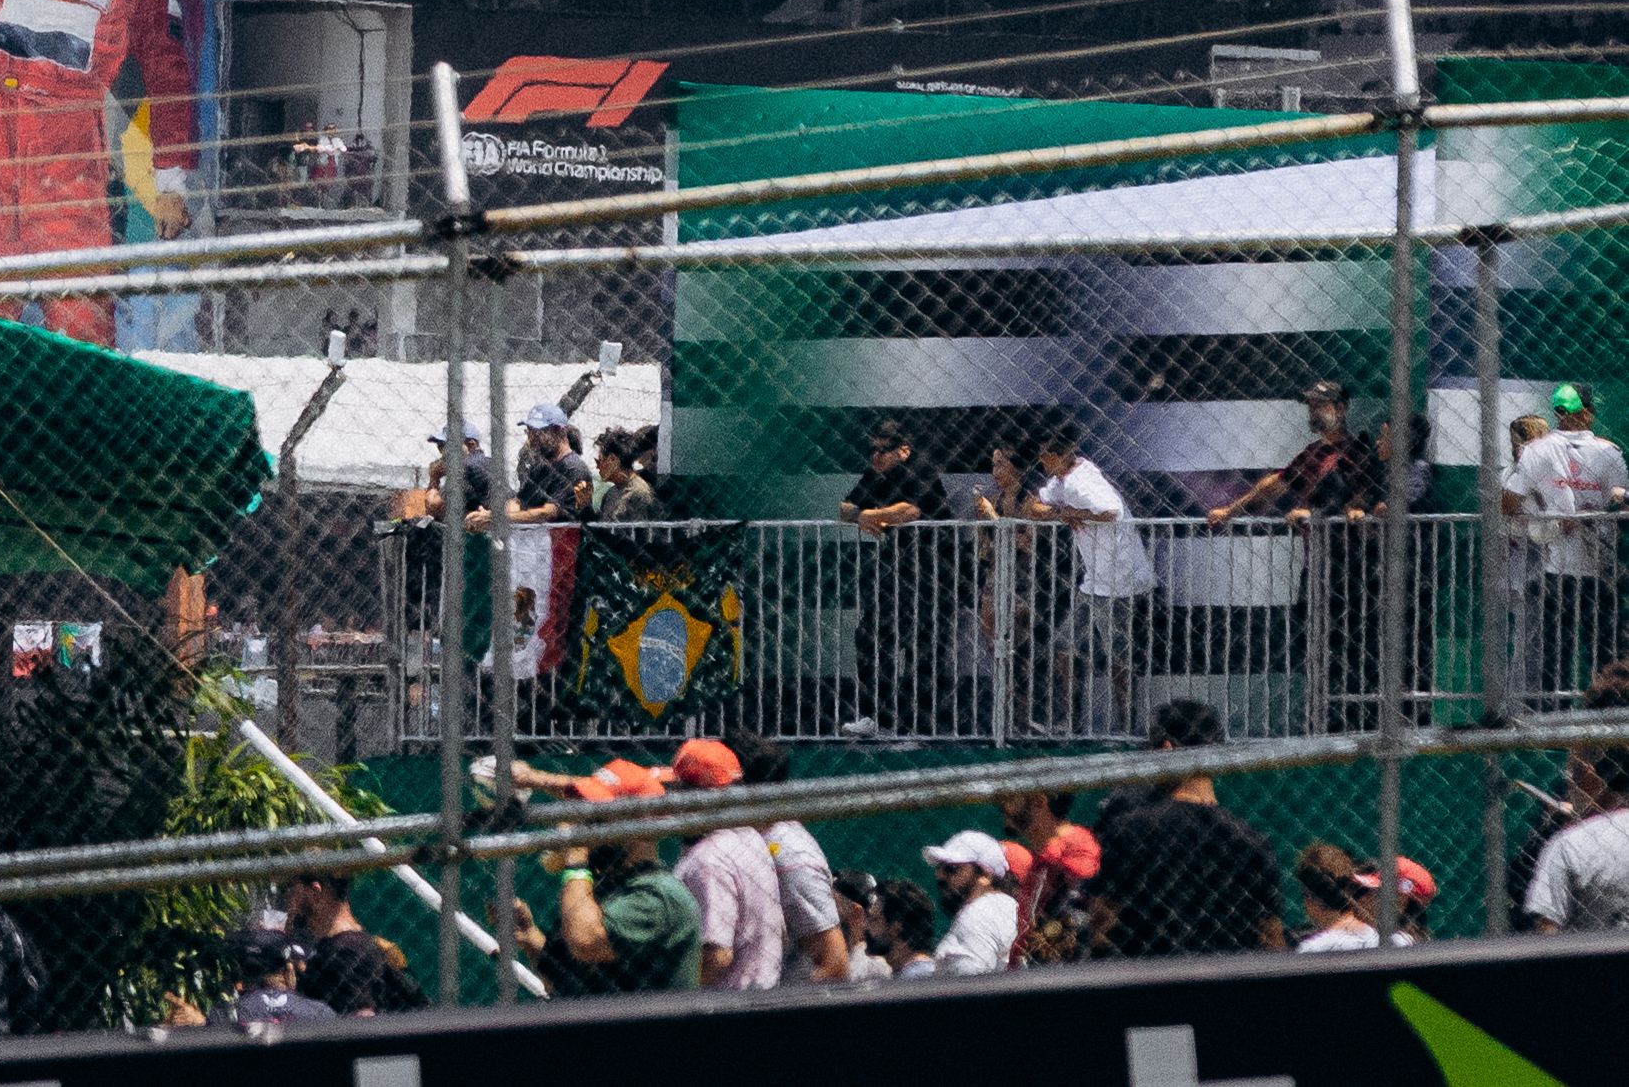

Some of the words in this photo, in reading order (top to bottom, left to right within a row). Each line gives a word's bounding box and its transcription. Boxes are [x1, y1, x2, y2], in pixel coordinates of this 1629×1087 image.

[507, 140, 530, 157] FIA
[532, 140, 598, 162] Formula
[507, 158, 553, 175] World
[555, 161, 663, 185] Championship
